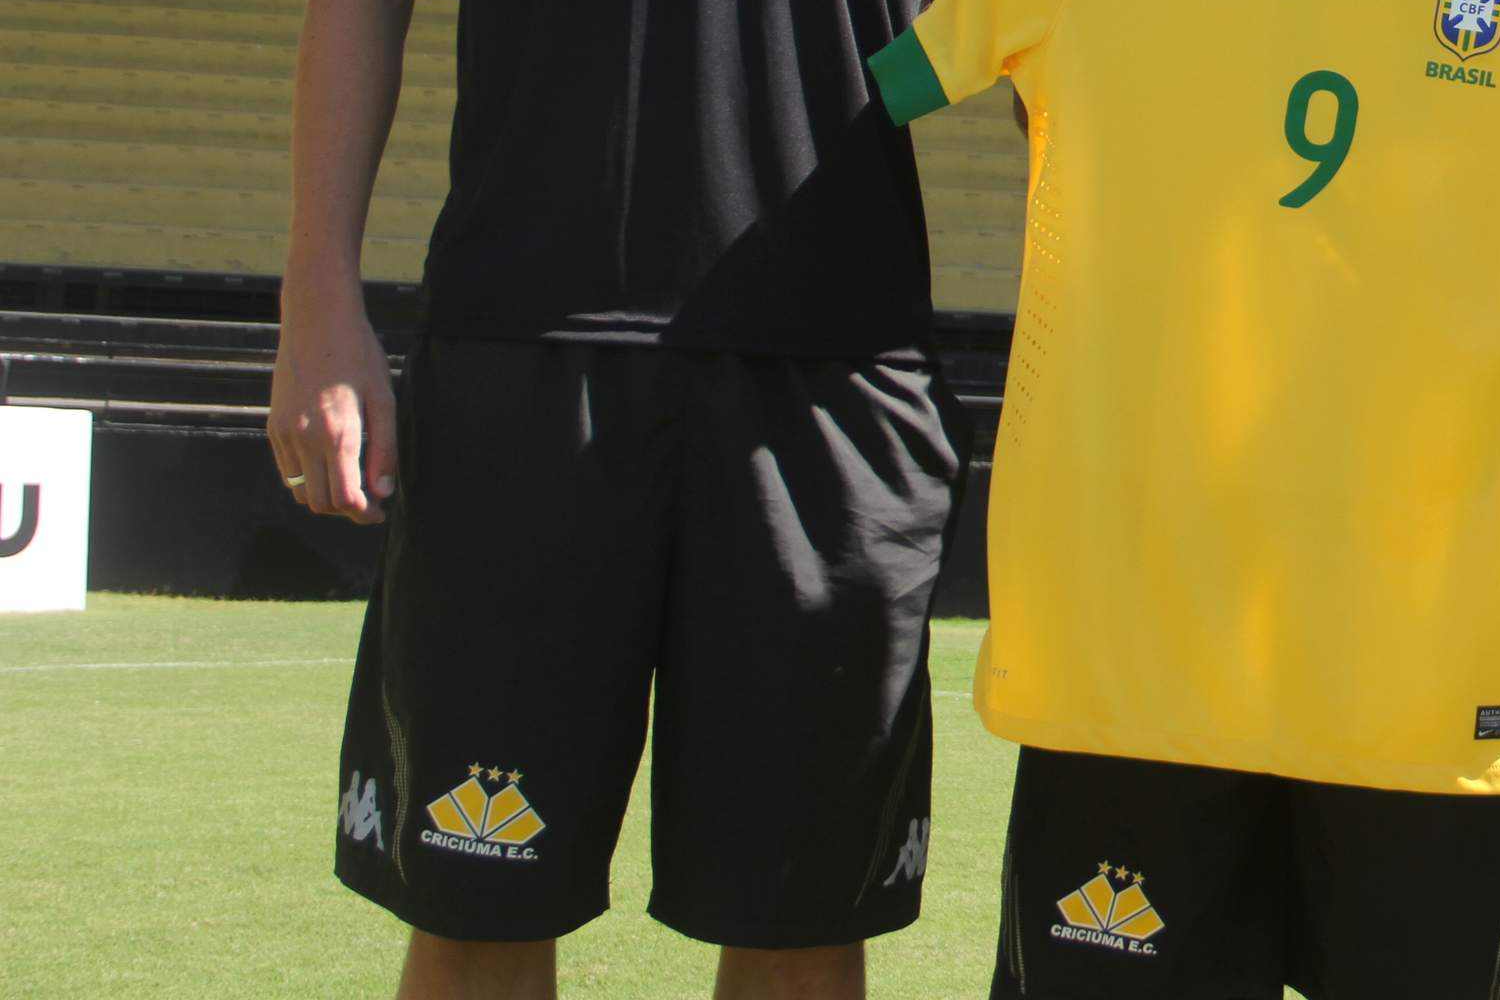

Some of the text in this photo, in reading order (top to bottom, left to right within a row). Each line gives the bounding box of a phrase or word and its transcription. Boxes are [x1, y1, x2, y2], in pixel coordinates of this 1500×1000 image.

[1459, 2, 1487, 16] CBF
[1425, 61, 1497, 89] BRASIL
[1278, 69, 1360, 209] 9
[420, 829, 539, 860] CRICIÚMA E.C.
[1127, 940, 1158, 955] E.C.
